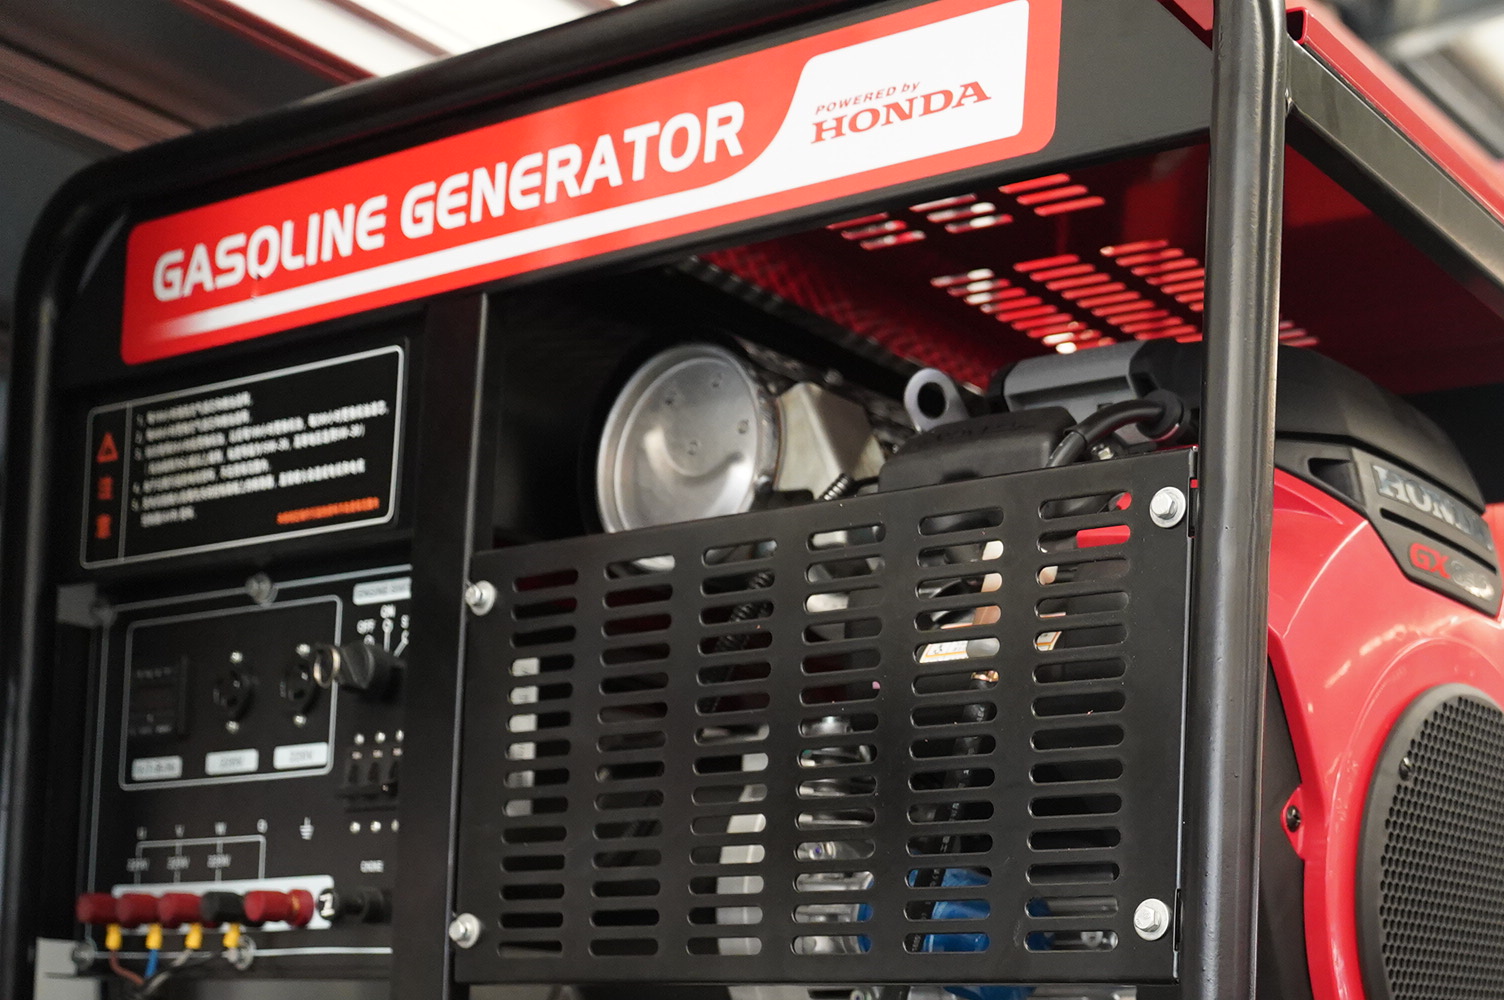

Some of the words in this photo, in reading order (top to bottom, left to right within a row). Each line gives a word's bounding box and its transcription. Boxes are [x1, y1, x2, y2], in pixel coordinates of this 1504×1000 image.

[811, 81, 992, 144] HONDA
[815, 86, 897, 115] POWERED
[901, 81, 920, 93] by
[153, 194, 388, 302] GASOLINE
[400, 101, 745, 239] GENERATOR
